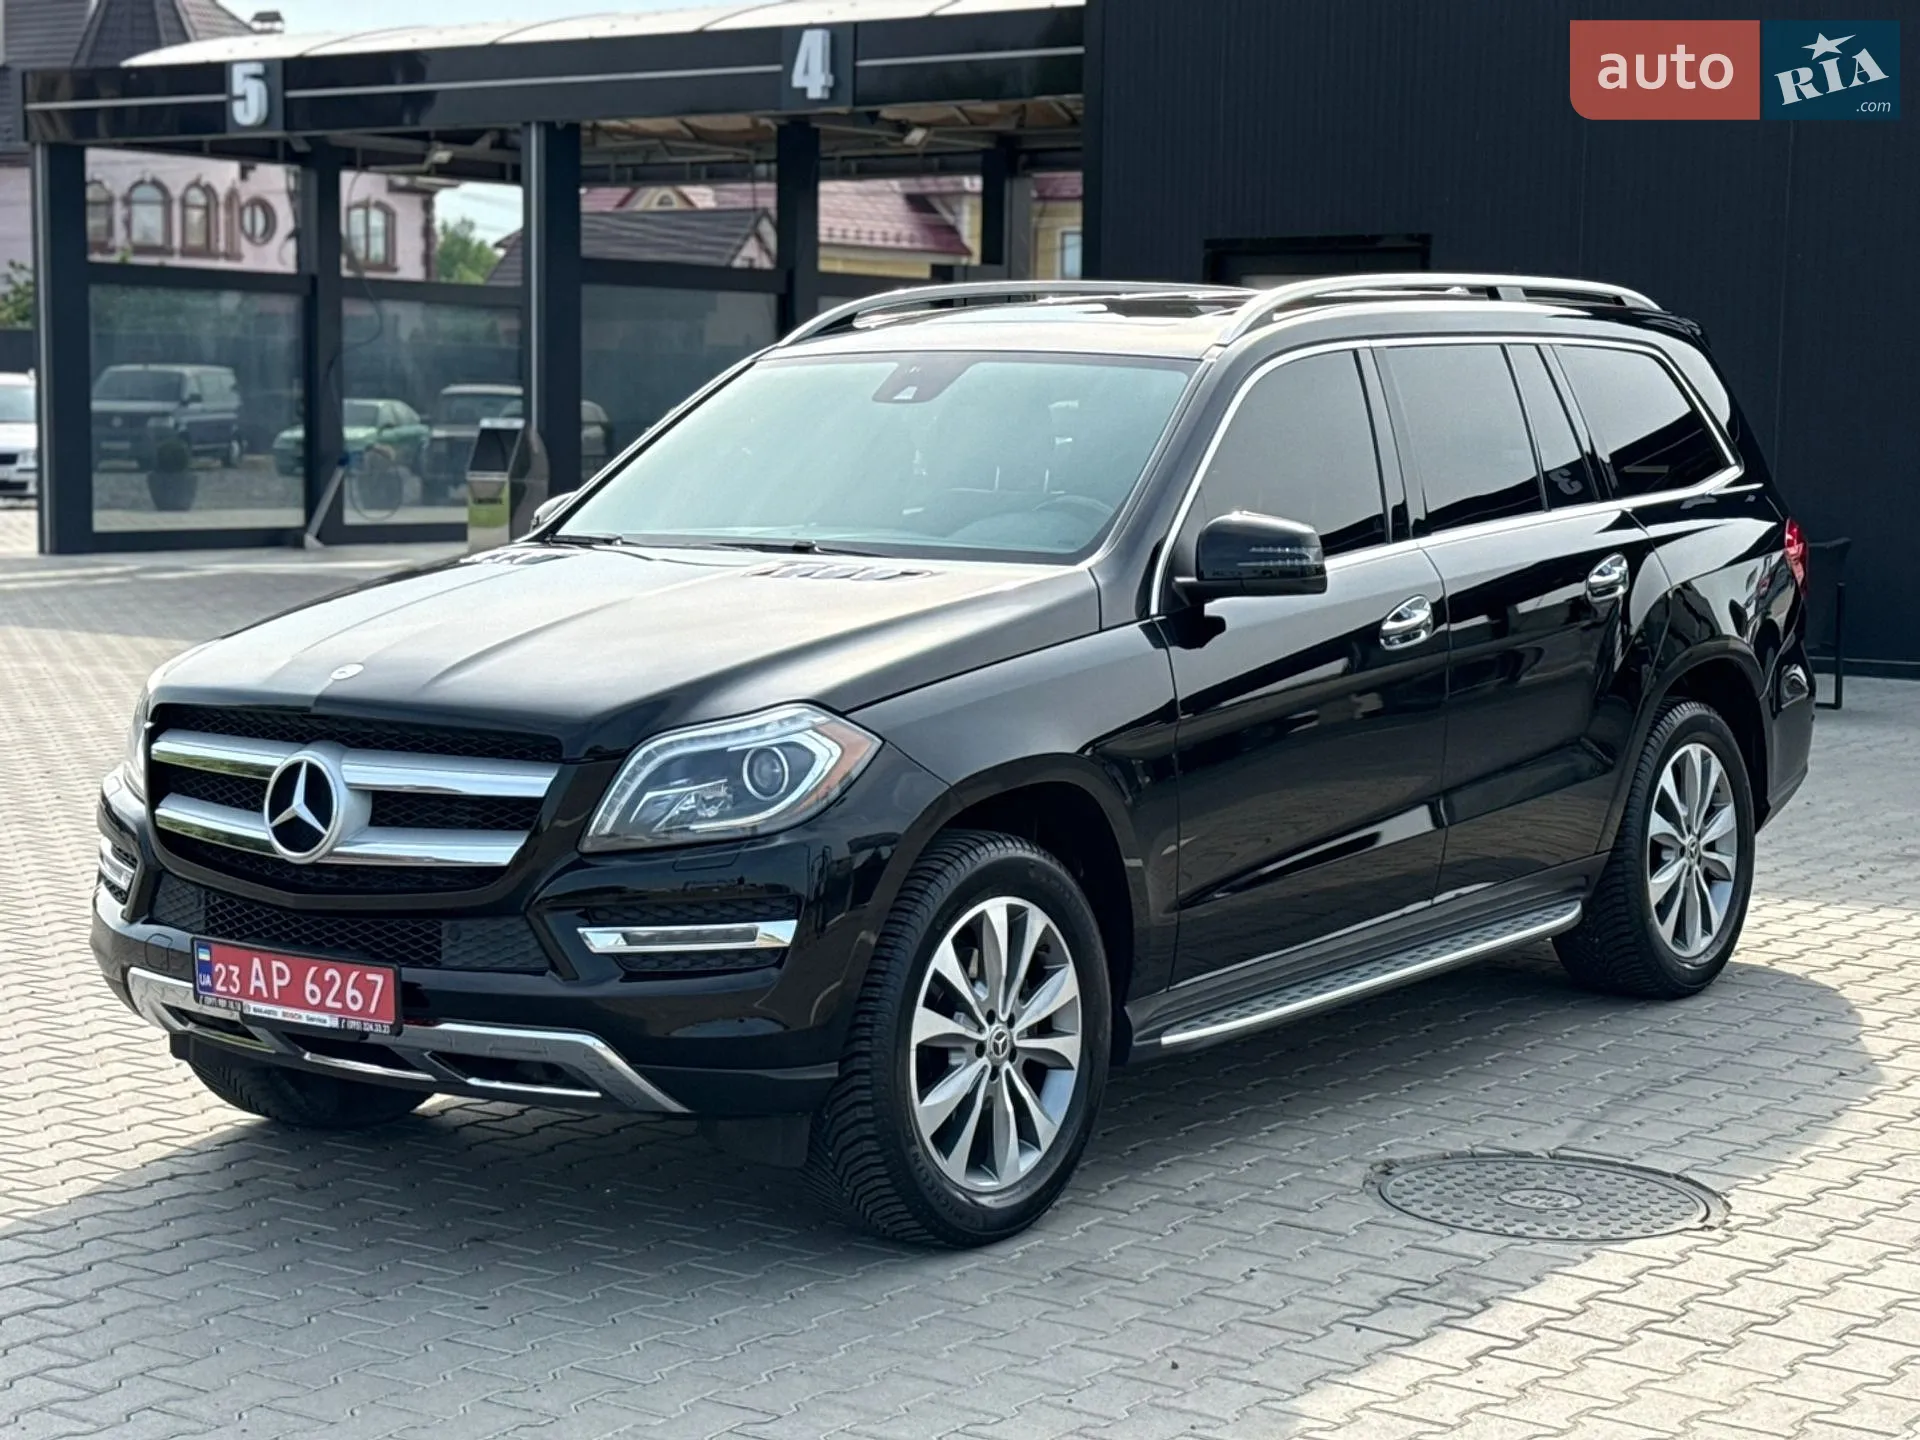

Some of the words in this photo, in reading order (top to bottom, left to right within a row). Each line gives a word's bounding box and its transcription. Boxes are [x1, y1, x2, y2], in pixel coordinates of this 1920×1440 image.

[231, 62, 268, 127] 5
[791, 29, 834, 100] 4
[199, 973, 213, 987] UA
[214, 963, 241, 994] 23
[249, 957, 291, 999] AP
[304, 966, 384, 1014] 6267
